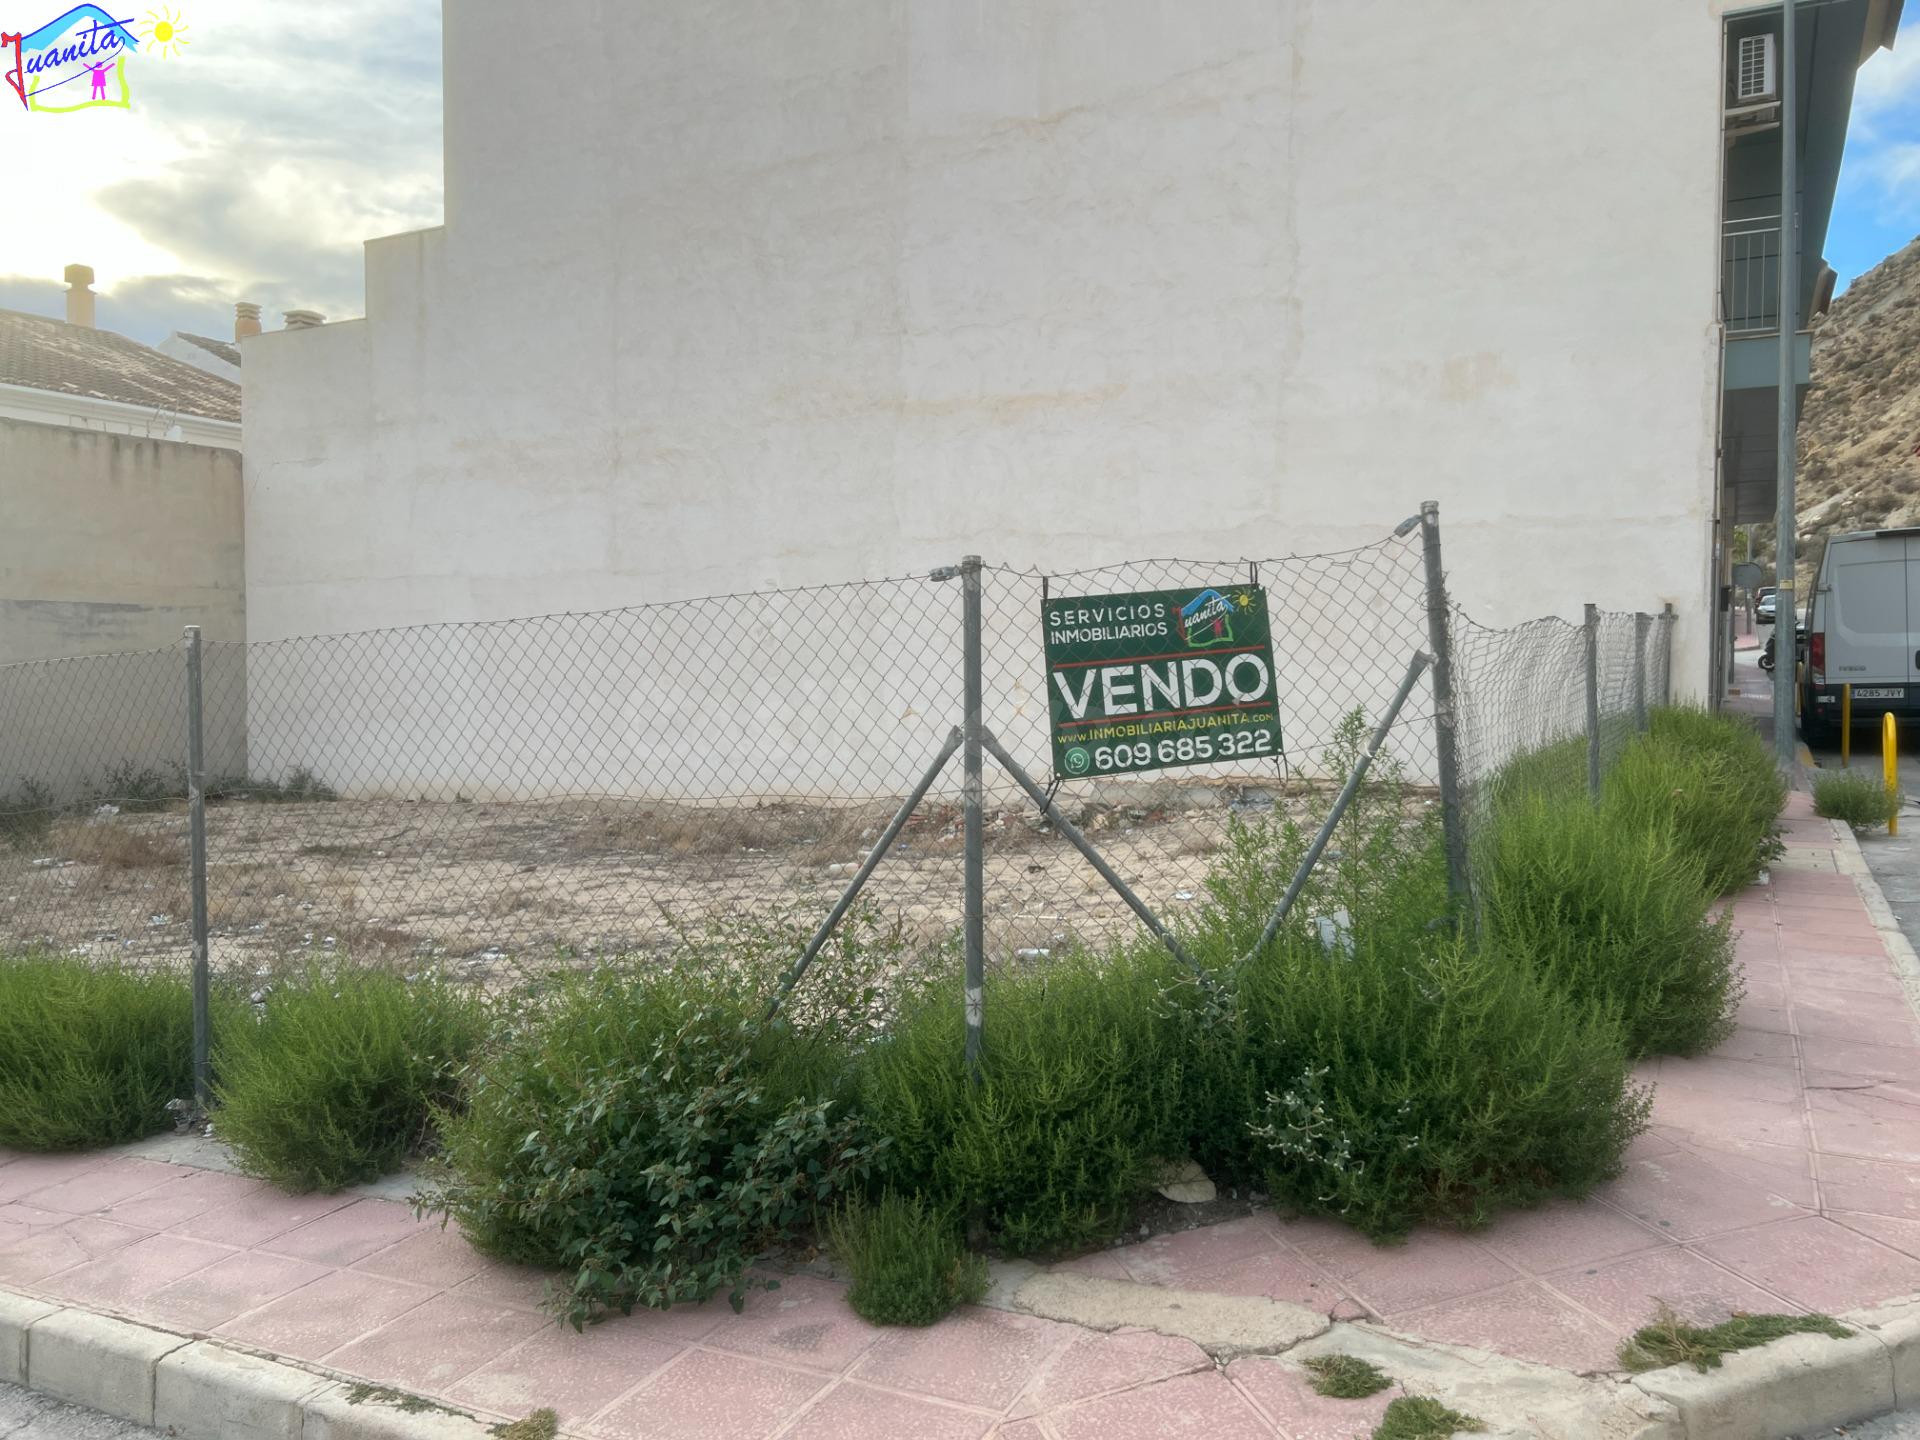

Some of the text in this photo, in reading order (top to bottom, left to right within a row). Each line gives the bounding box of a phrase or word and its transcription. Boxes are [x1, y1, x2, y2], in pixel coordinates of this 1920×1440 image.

[1050, 603, 1165, 626] SERVICIOS
[1171, 594, 1231, 640] Juanita
[1051, 622, 1167, 645] INMOBILIARIOS
[1053, 653, 1268, 719] VENDO
[1856, 688, 1881, 697] 4285
[1095, 729, 1272, 770] 609 685 322
